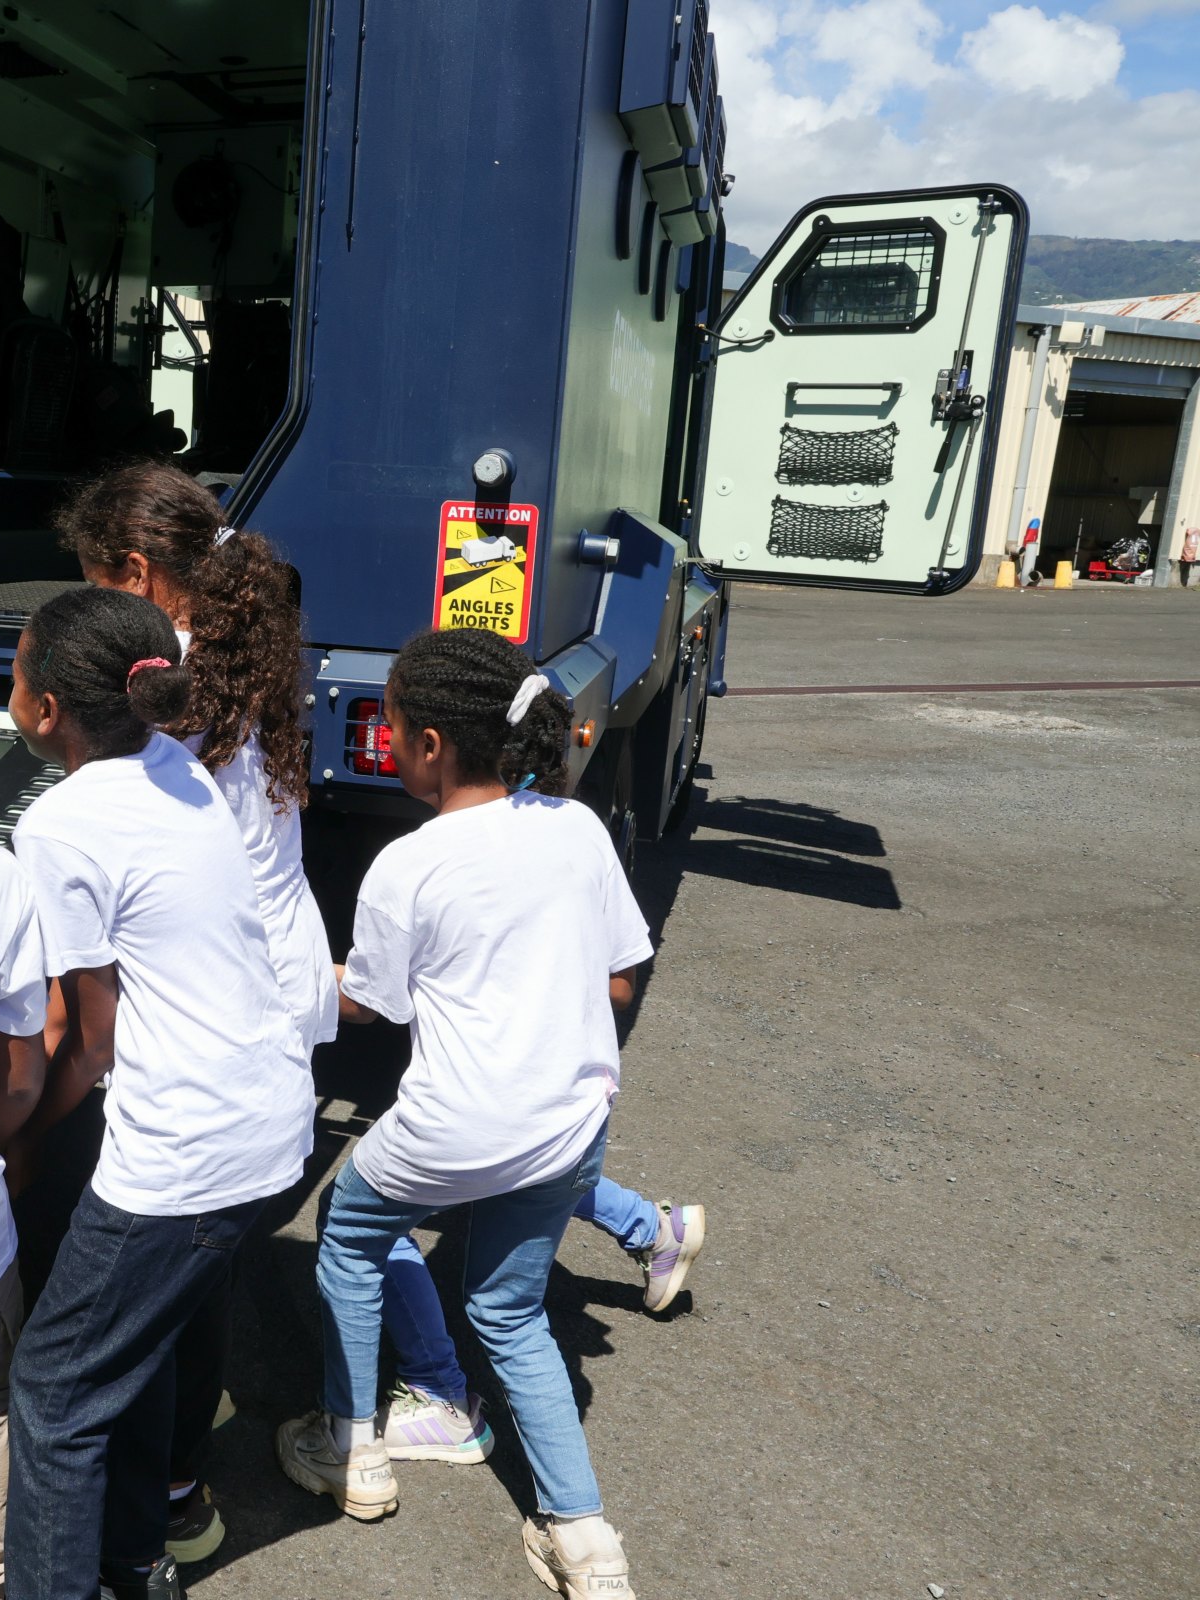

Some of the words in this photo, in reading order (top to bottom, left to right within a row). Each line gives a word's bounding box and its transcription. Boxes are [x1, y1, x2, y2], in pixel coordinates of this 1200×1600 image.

[448, 506, 531, 522] ATTENTION
[449, 598, 514, 616] ANGLES
[452, 614, 510, 630] MORTS
[370, 1470, 390, 1481] FILA
[598, 1580, 624, 1589] FILA
